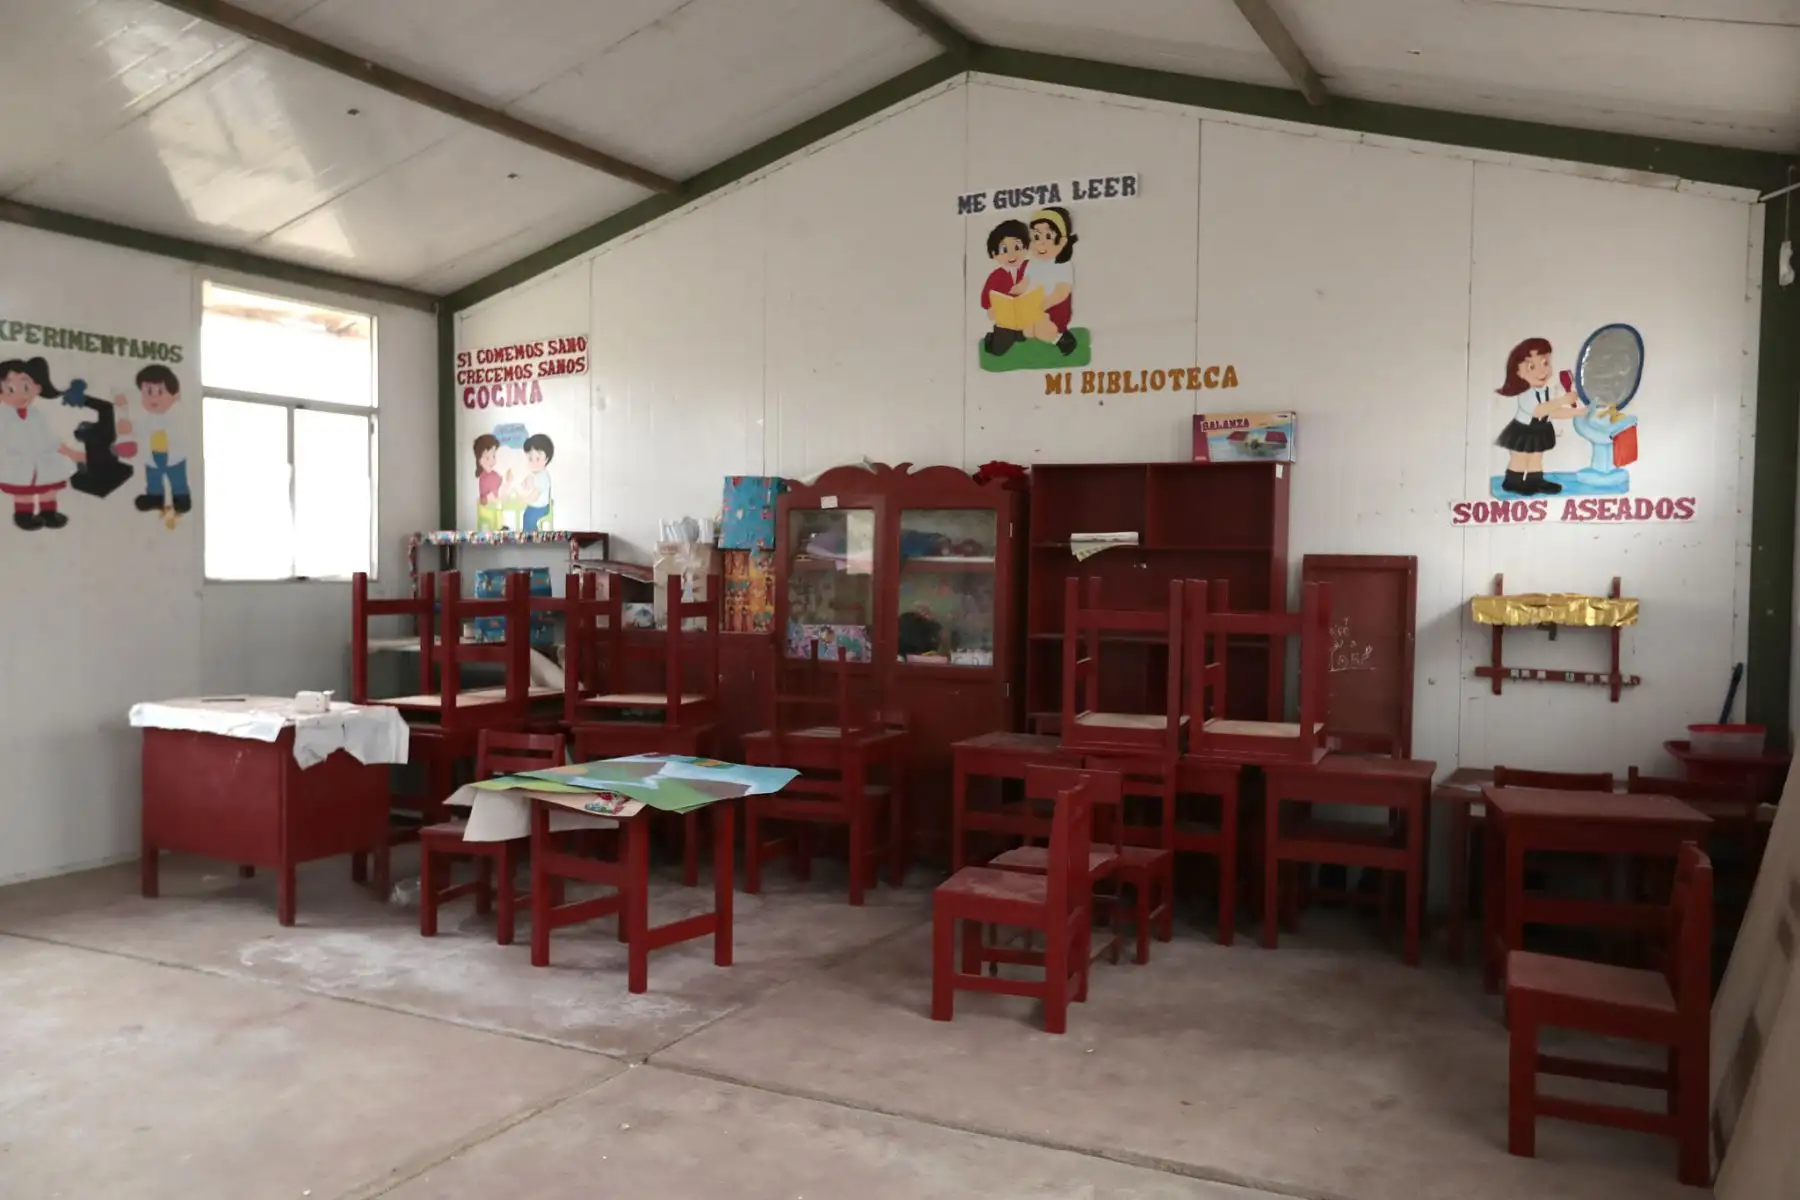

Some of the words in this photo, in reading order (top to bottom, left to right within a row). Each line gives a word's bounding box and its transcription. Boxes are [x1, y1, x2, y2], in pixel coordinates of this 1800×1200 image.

[958, 192, 987, 215] ME
[993, 183, 1062, 210] GUSTA
[1072, 175, 1137, 201] LEER
[457, 352, 472, 368] SI
[476, 342, 544, 365] COMEMOS
[457, 364, 533, 385] CRECEMOS
[538, 356, 586, 378] SANOS
[1045, 372, 1072, 395] MI
[1081, 365, 1239, 394] BIBLIOTECA
[463, 380, 544, 409] COCINA
[1202, 418, 1250, 431] BALANZA
[1453, 500, 1548, 524] SOMOS
[1561, 497, 1696, 522] ASEADOS
